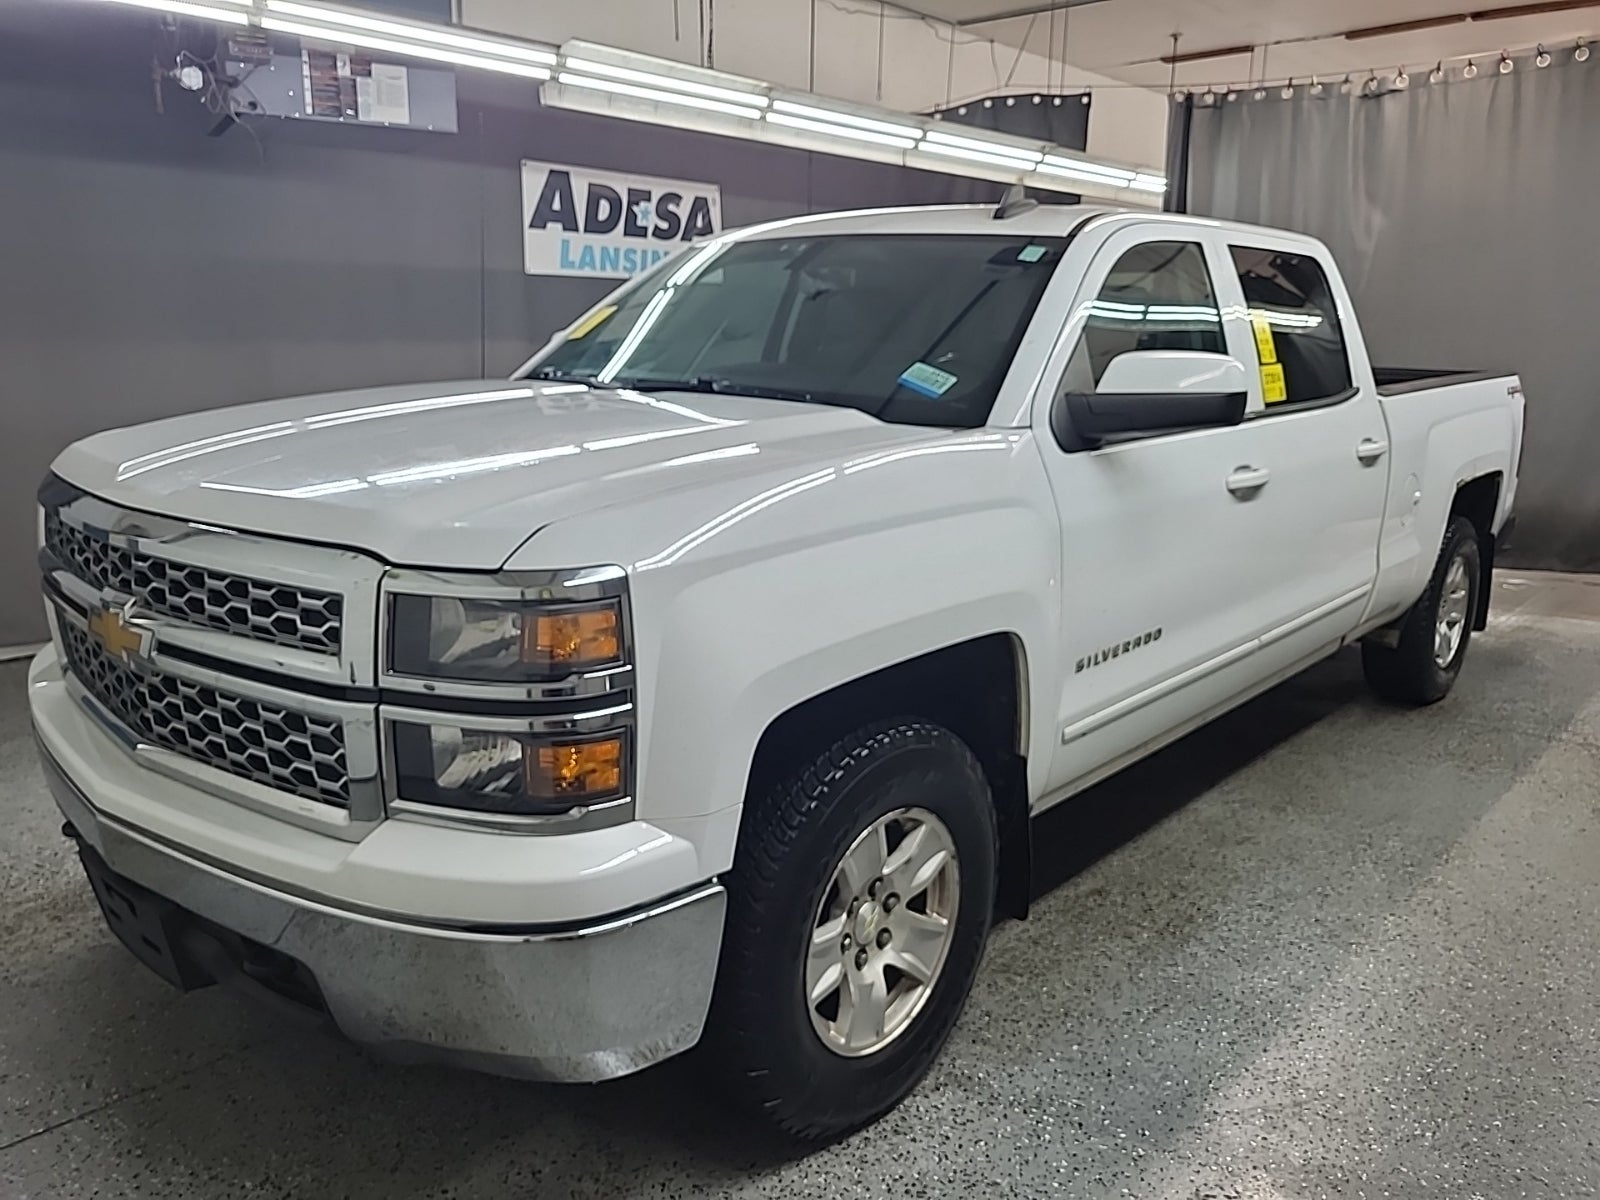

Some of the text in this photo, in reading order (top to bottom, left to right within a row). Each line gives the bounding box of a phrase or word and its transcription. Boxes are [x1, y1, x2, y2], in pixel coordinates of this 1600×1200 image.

[529, 169, 714, 242] ADESA
[560, 238, 670, 274] LANSI
[1074, 626, 1163, 675] SILVERADO
